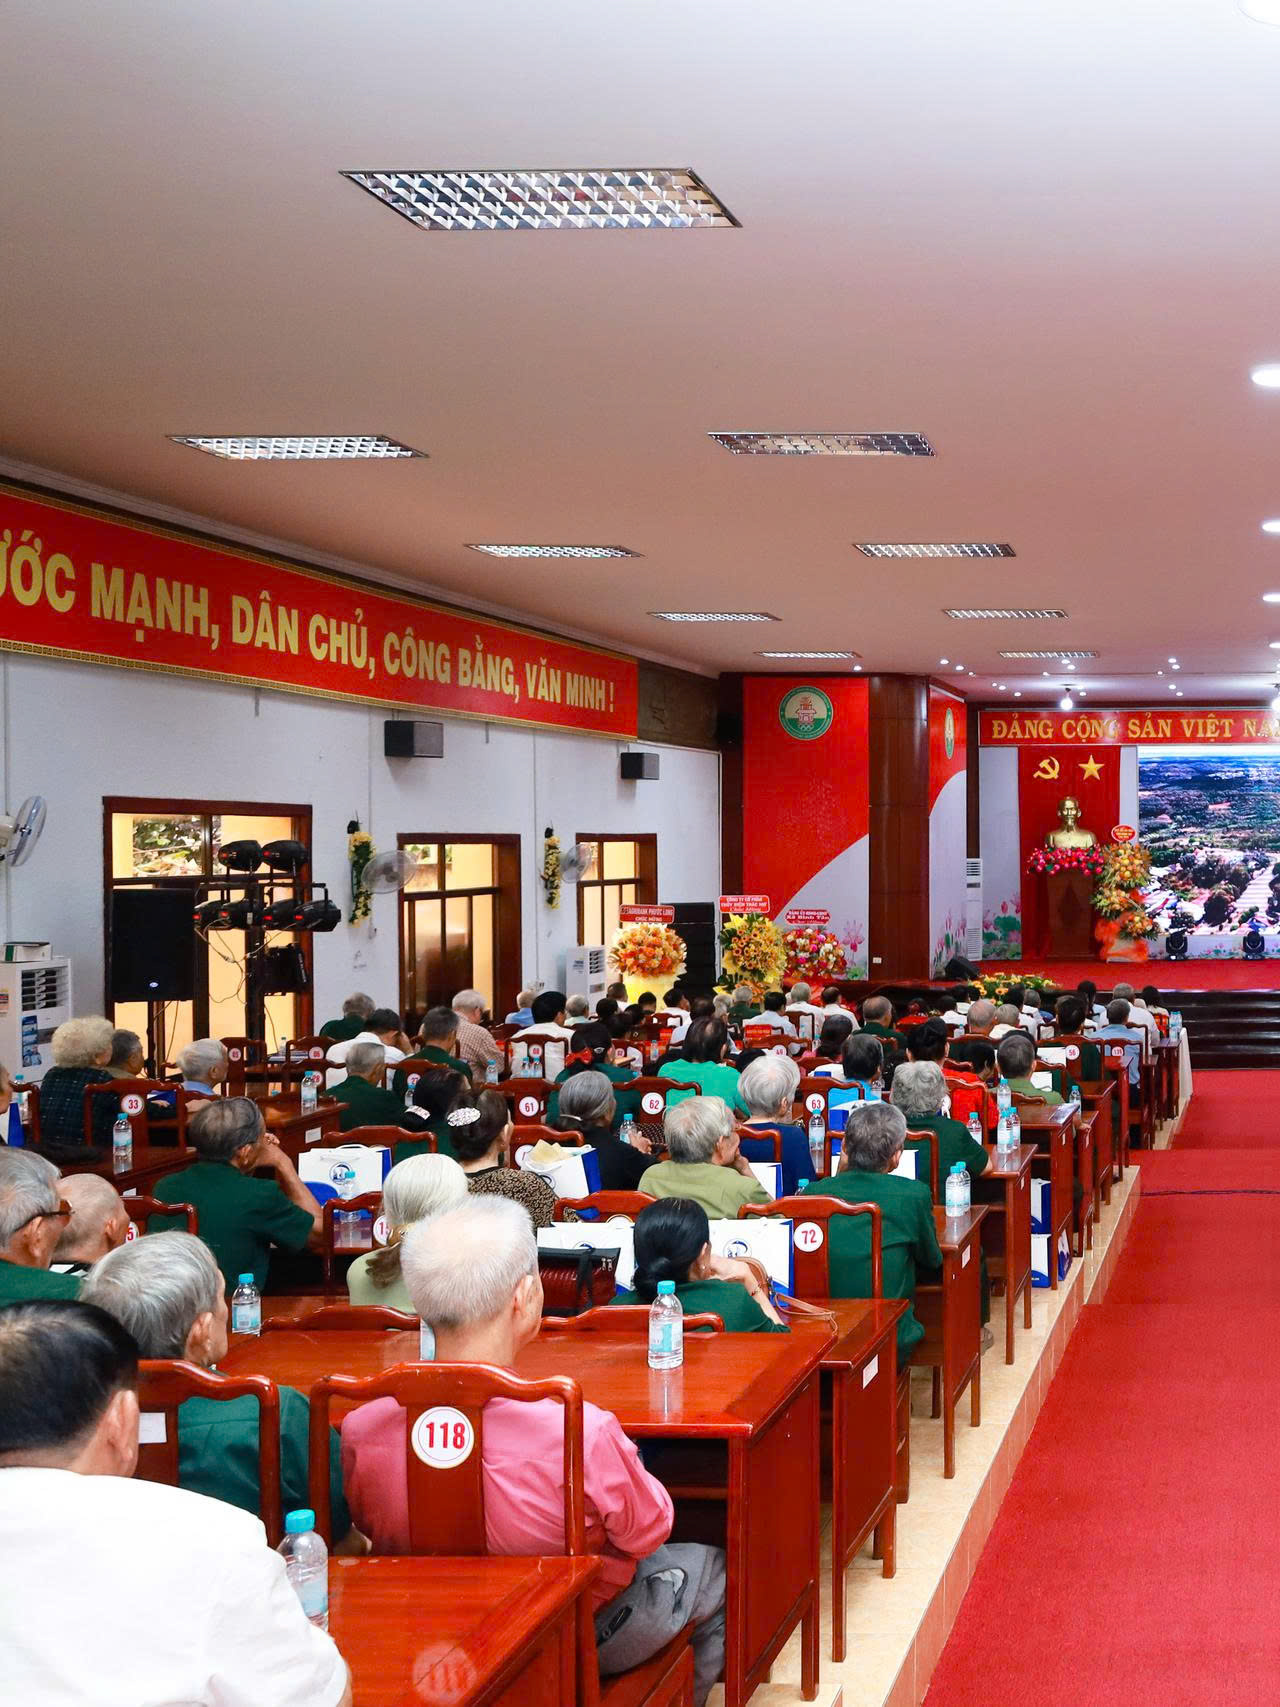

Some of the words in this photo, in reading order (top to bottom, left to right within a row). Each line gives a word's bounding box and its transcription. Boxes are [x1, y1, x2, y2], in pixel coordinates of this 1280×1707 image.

[91, 562, 220, 650] MẠNH,
[232, 590, 299, 655] DÂN
[308, 607, 375, 679] CHỦ,
[383, 627, 450, 684] CÔNG
[458, 634, 519, 703] BẰNG,
[525, 657, 561, 702] VĂN
[566, 672, 605, 711] MINH
[992, 713, 1054, 739] ĐẢNG
[1061, 715, 1118, 743] CỘNG
[1128, 713, 1172, 739] SẢN
[1181, 714, 1234, 743] VIỆT
[128, 1099, 138, 1109] 33
[525, 1102, 535, 1112] 61
[649, 1099, 659, 1110] 62
[811, 1099, 821, 1109] 63
[801, 1229, 817, 1244] 72
[426, 1421, 465, 1450] 118
